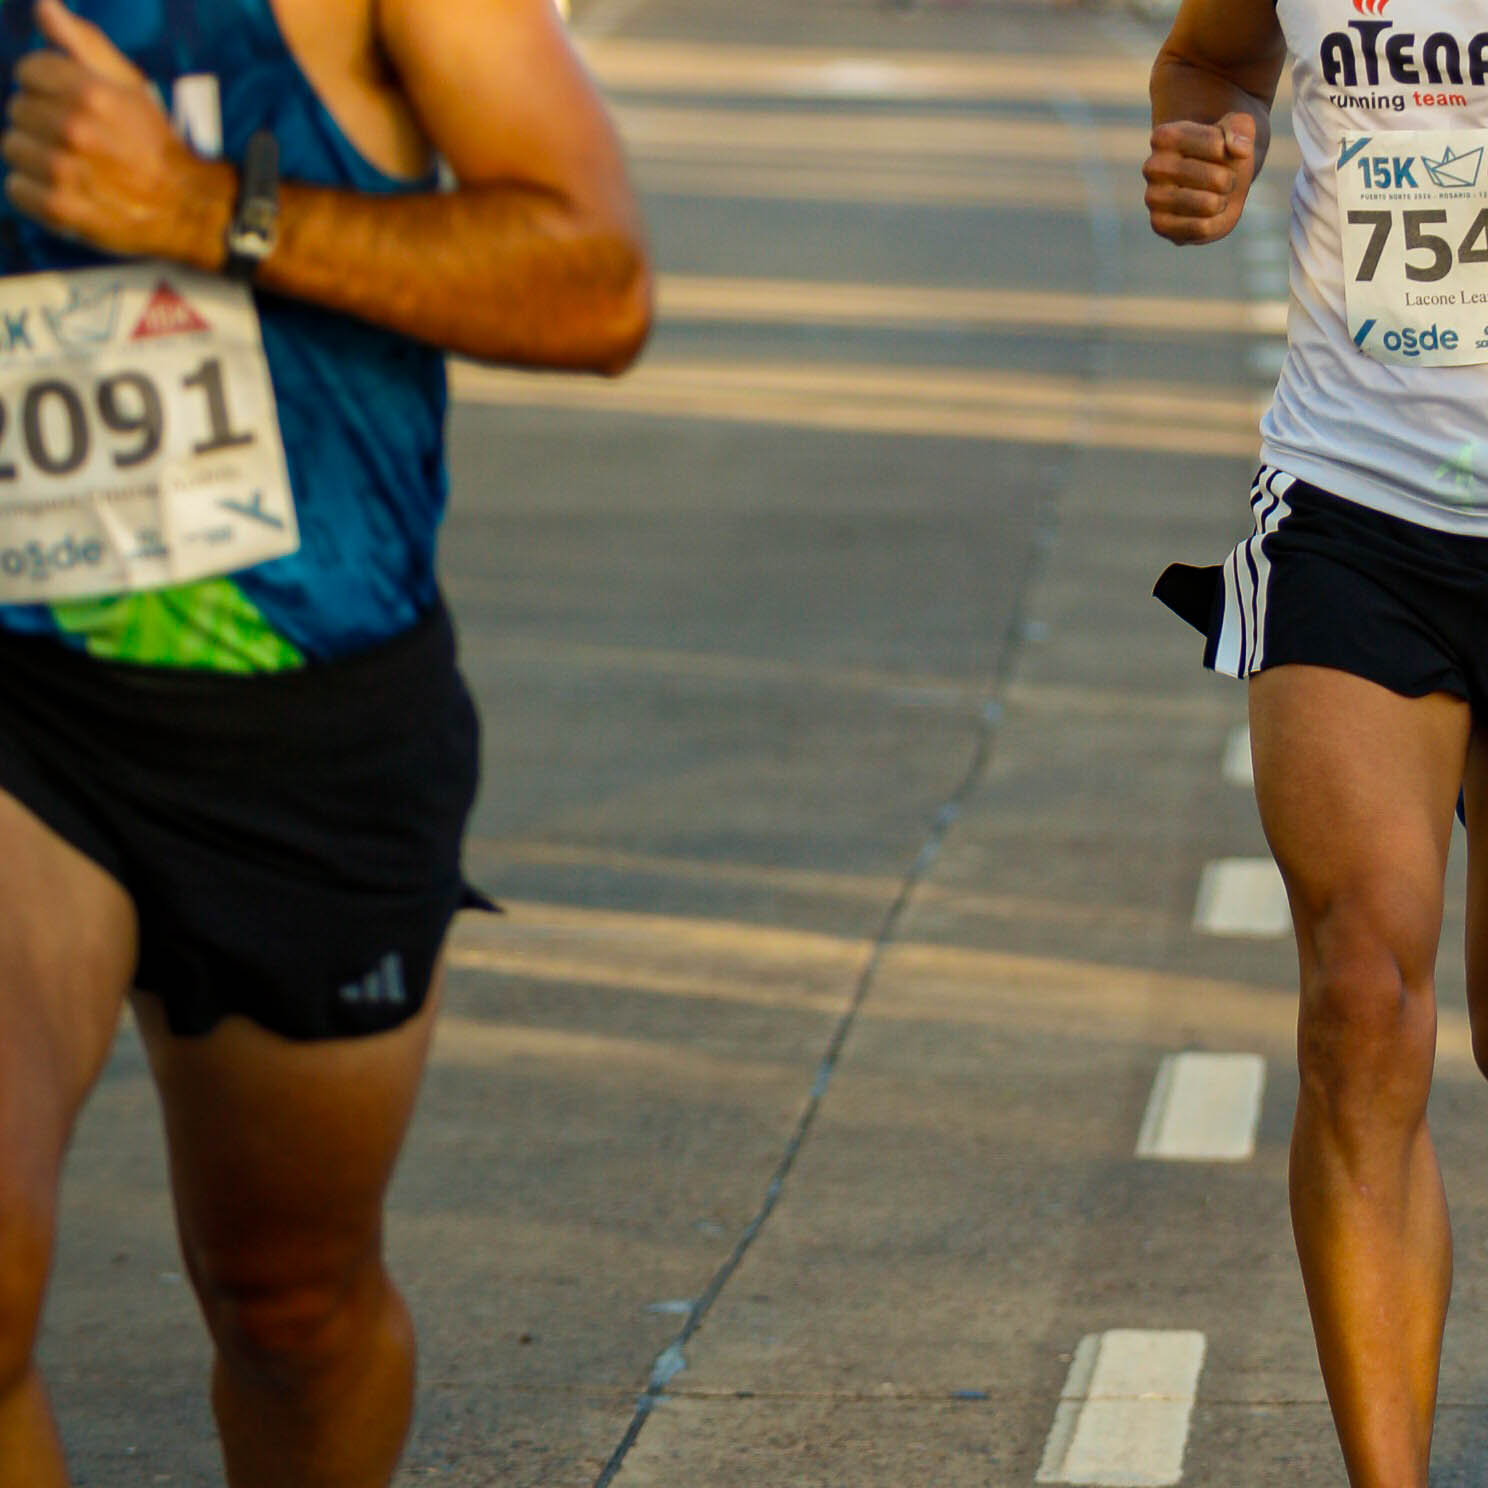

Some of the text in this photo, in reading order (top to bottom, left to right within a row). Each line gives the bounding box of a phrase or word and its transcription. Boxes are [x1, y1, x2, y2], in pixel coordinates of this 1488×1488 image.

[1330, 91, 1468, 111] running team
[1357, 156, 1418, 189] 15K
[1405, 291, 1456, 307] Lacone
[1383, 323, 1459, 357] osde
